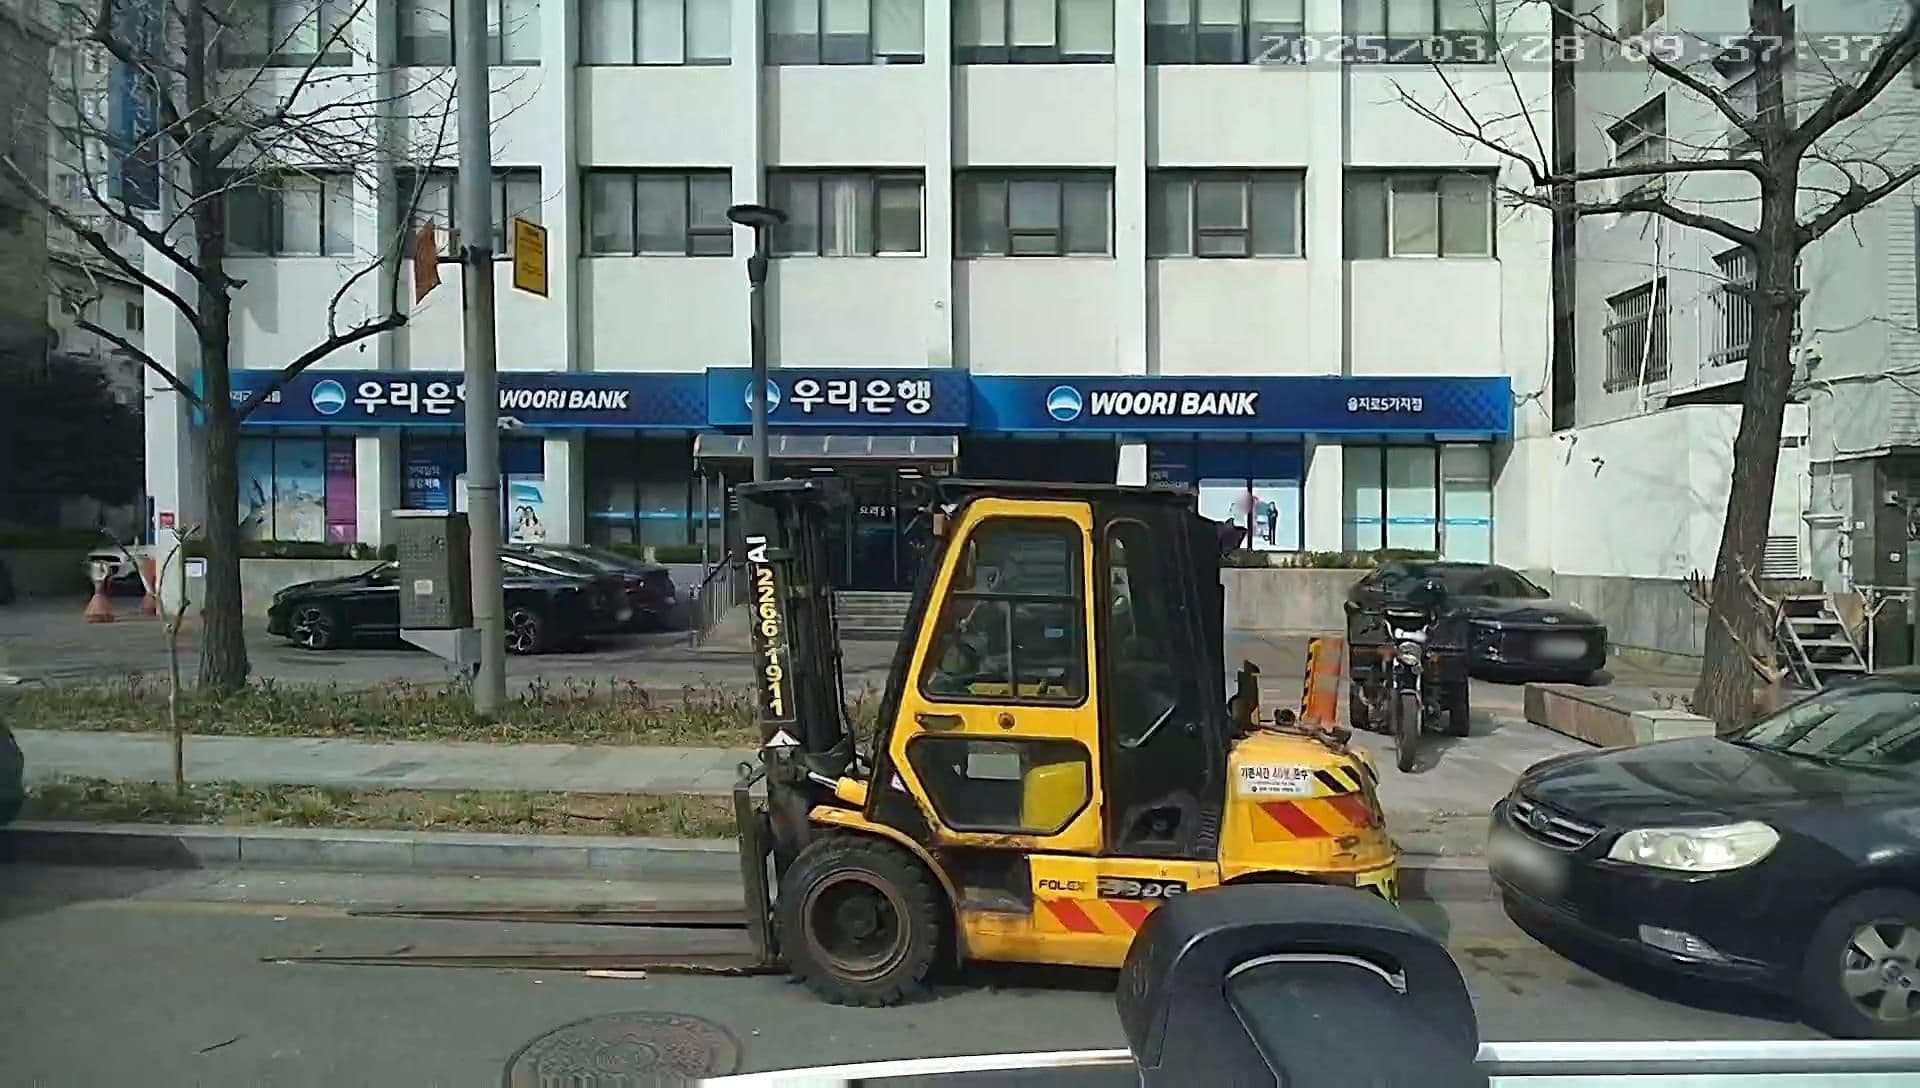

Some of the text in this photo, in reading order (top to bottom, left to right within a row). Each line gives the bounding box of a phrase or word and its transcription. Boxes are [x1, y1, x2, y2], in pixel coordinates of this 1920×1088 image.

[353, 381, 466, 416] 우리은
[499, 388, 629, 411] WOORI BANK
[789, 378, 932, 415] 우리은행
[1090, 390, 1258, 416] WOORI BANK
[1346, 396, 1424, 412] 을지로5가지점
